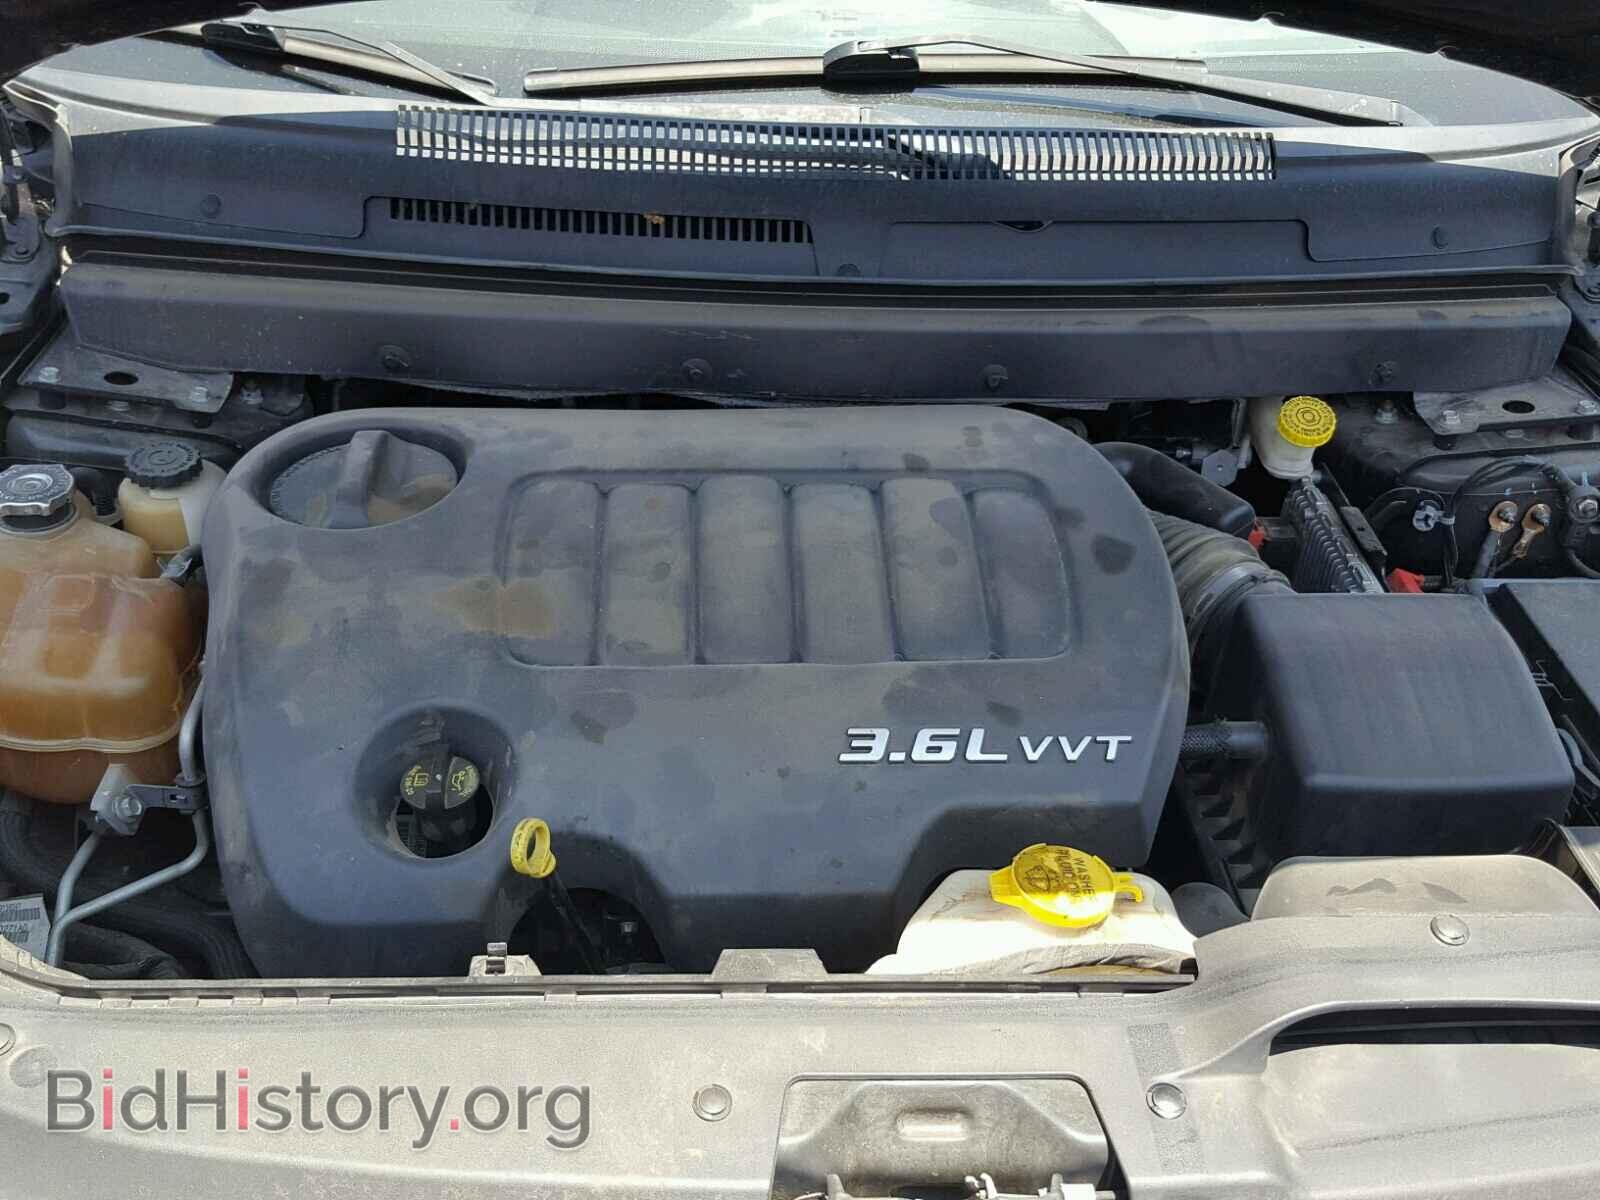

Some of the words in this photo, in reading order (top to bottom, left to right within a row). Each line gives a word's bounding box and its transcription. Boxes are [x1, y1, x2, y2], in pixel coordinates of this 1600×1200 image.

[838, 727, 1008, 764] 3.6L
[1019, 734, 1132, 763] VVT
[1072, 857, 1095, 897] WASHE
